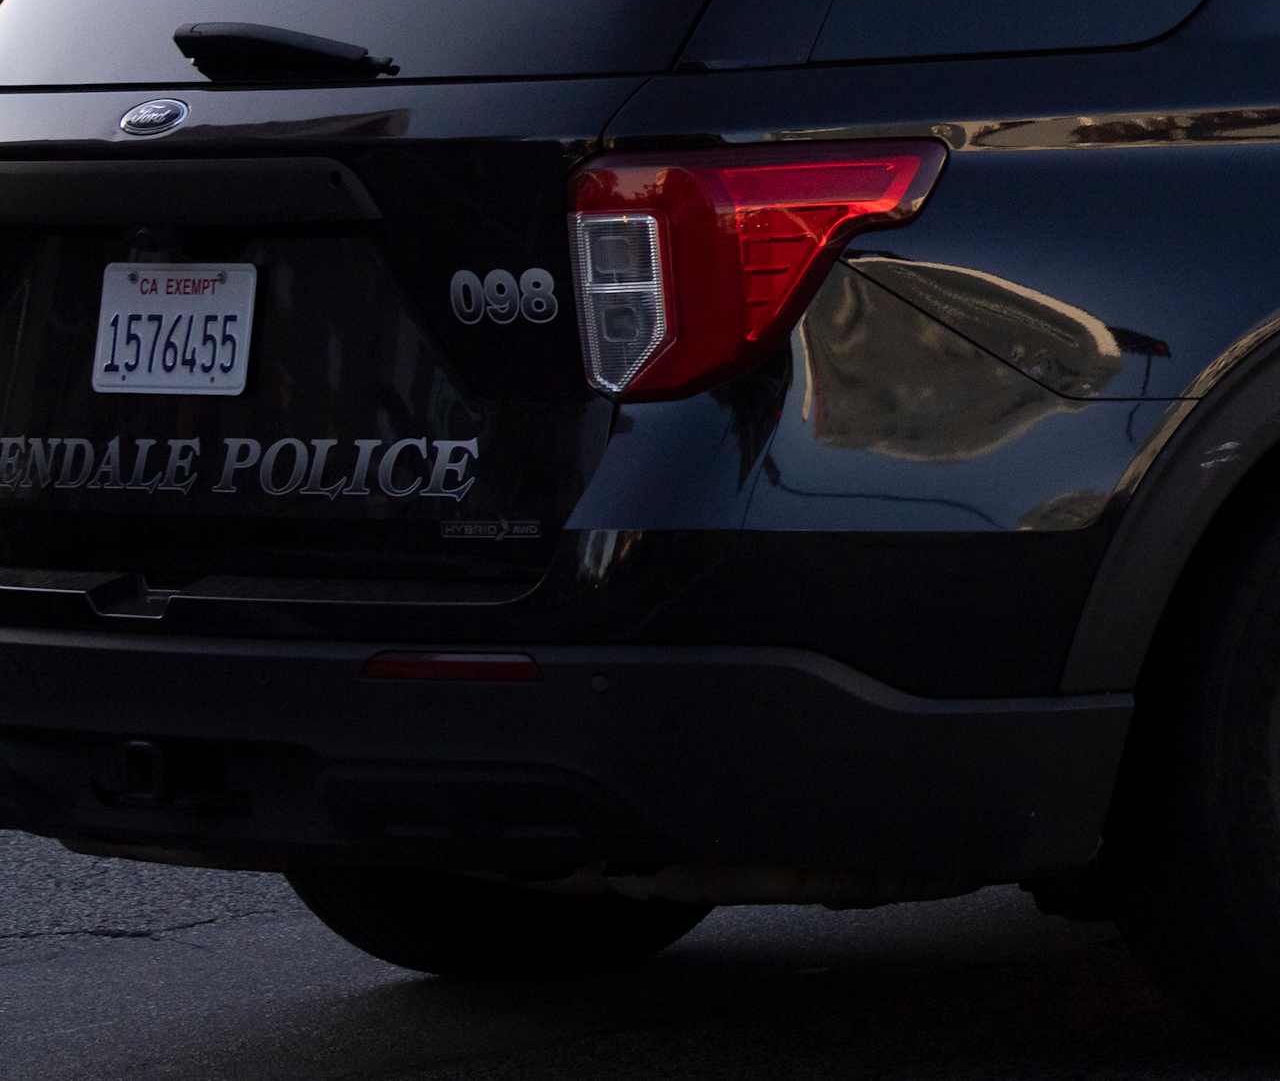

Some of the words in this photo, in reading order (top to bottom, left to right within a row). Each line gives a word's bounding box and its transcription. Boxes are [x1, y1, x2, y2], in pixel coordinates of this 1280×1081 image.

[130, 103, 175, 124] Ford
[140, 278, 159, 295] CA
[165, 278, 218, 295] EXEMPT
[450, 268, 559, 325] 098
[103, 314, 238, 375] 1576455
[212, 436, 480, 503] POLICE
